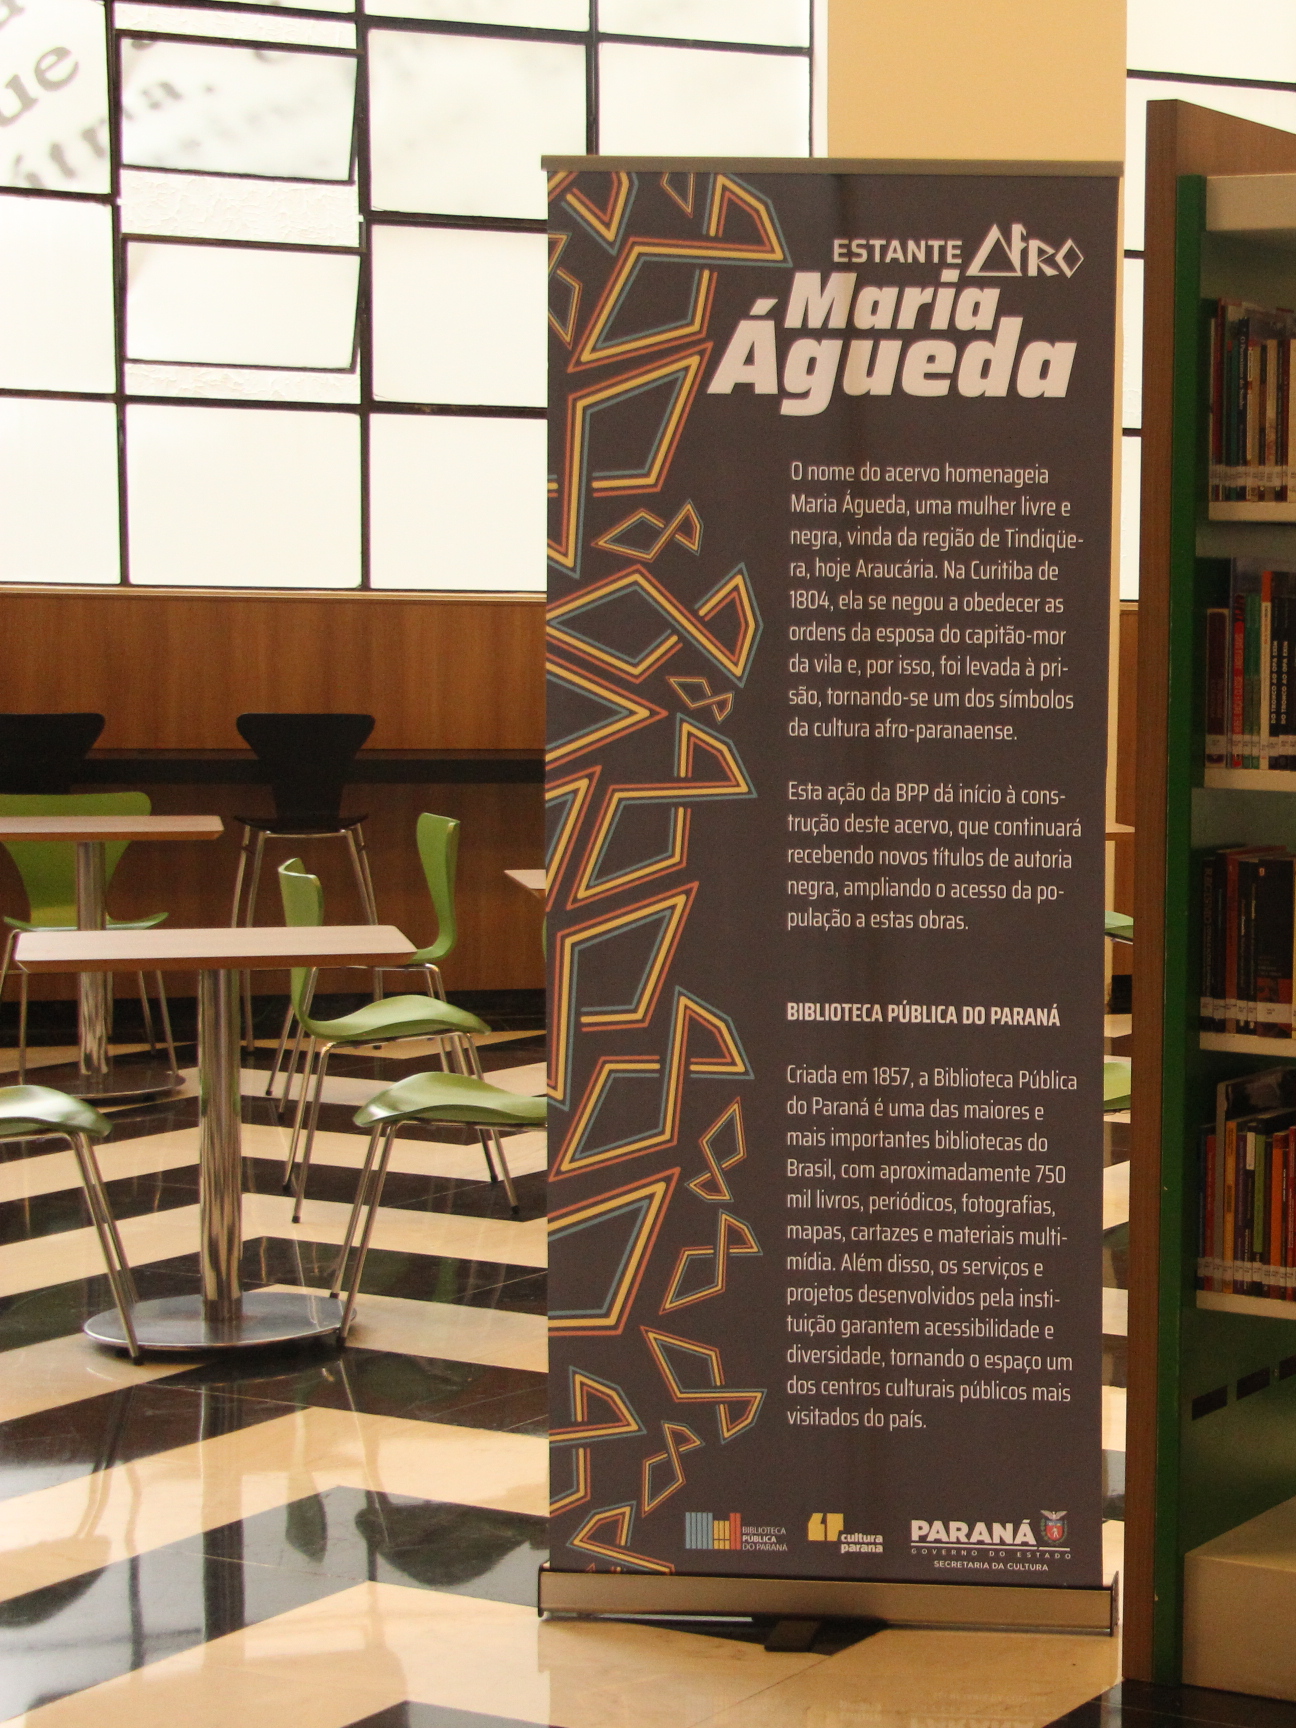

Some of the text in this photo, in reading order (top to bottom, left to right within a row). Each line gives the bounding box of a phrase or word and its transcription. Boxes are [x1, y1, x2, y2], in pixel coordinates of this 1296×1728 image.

[833, 239, 963, 264] ESTANTE
[784, 269, 1000, 331] Maria
[707, 298, 1077, 417] Águeda
[791, 461, 1049, 489] O nome do acervo homenageia
[791, 489, 1071, 519] Maria Águeda, uma mulher livre e
[790, 525, 1084, 553] negra, vinda da região de Tindiqüe-
[789, 556, 1059, 583] ra, hoje Araucária. Na Curitiba de
[789, 589, 1064, 616] 1804, ela se negou a obedecer as
[789, 621, 1067, 649] ordens da esposa do capitão-mor
[789, 652, 1069, 682] da vila e, por isso, foi levada à pri-
[788, 685, 1075, 710] são, tornando-se um dos símbolos
[788, 716, 1018, 743] da cultura afro-paranaense.
[788, 781, 1066, 805] Esta ação da BPP dá início à cons-
[787, 812, 1082, 840] trução deste acervo, que continuará
[787, 876, 1065, 905] negra, ampliando o acesso da po-
[787, 999, 1061, 1027] BIBLIOTECA PÚBLICA DO PARANÁ
[786, 1063, 1077, 1091] Criada em 1857, a Biblioteca Pública
[786, 1095, 1045, 1121] do Paraná é uma das maiores e
[786, 1126, 1048, 1153] mais importantes bibliotecas do
[787, 1158, 1066, 1184] Brasil, com aproximadamente 750
[787, 1188, 1056, 1218] mil livros, periódicos, fotografias,
[787, 1374, 1071, 1403] dos centros culturais públicos mais
[786, 1405, 927, 1432] visitados do país.
[742, 1526, 787, 1535] BIBLIOTECA
[742, 1533, 777, 1543] PÚBLICA
[840, 1533, 884, 1543] cultura
[911, 1519, 1037, 1545] PARANÁ
[742, 1542, 788, 1551] DO PARANÁ
[840, 1543, 884, 1553] parana
[911, 1548, 978, 1557] GOVERNO
[1017, 1551, 1072, 1560] ESTADO
[934, 1560, 1049, 1571] SECRETARIA DA CULTURA
